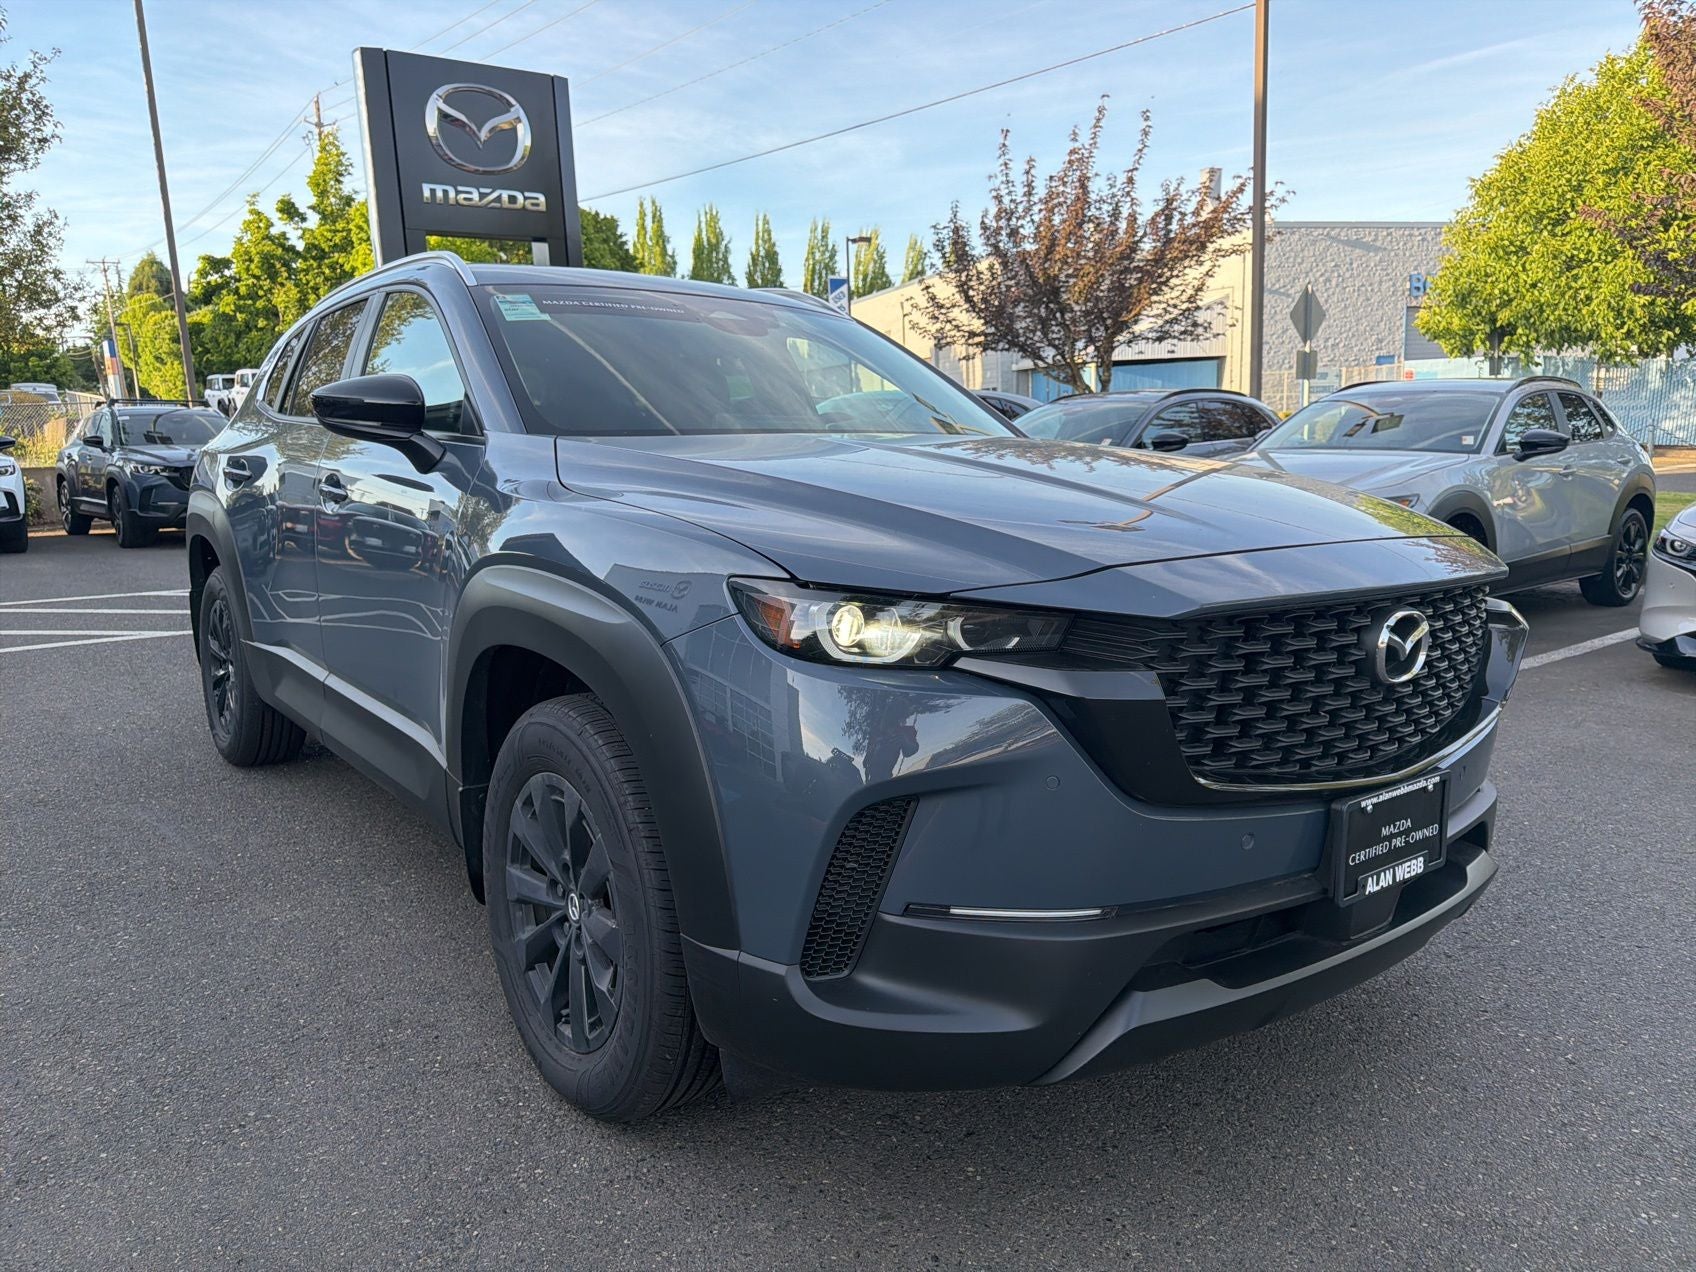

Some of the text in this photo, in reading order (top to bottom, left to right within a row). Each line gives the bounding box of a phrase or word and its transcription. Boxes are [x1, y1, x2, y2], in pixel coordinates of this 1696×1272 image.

[421, 182, 547, 212] mazda
[581, 301, 628, 309] CERTIFIED
[630, 304, 685, 314] PRE-OWNED
[1360, 775, 1441, 808] www.alanwebbmazda.com
[1381, 818, 1412, 838] MAZDA
[1348, 823, 1440, 866] CERTIFIED PRE-OWNED
[1365, 856, 1425, 895] ALAN WEBB
